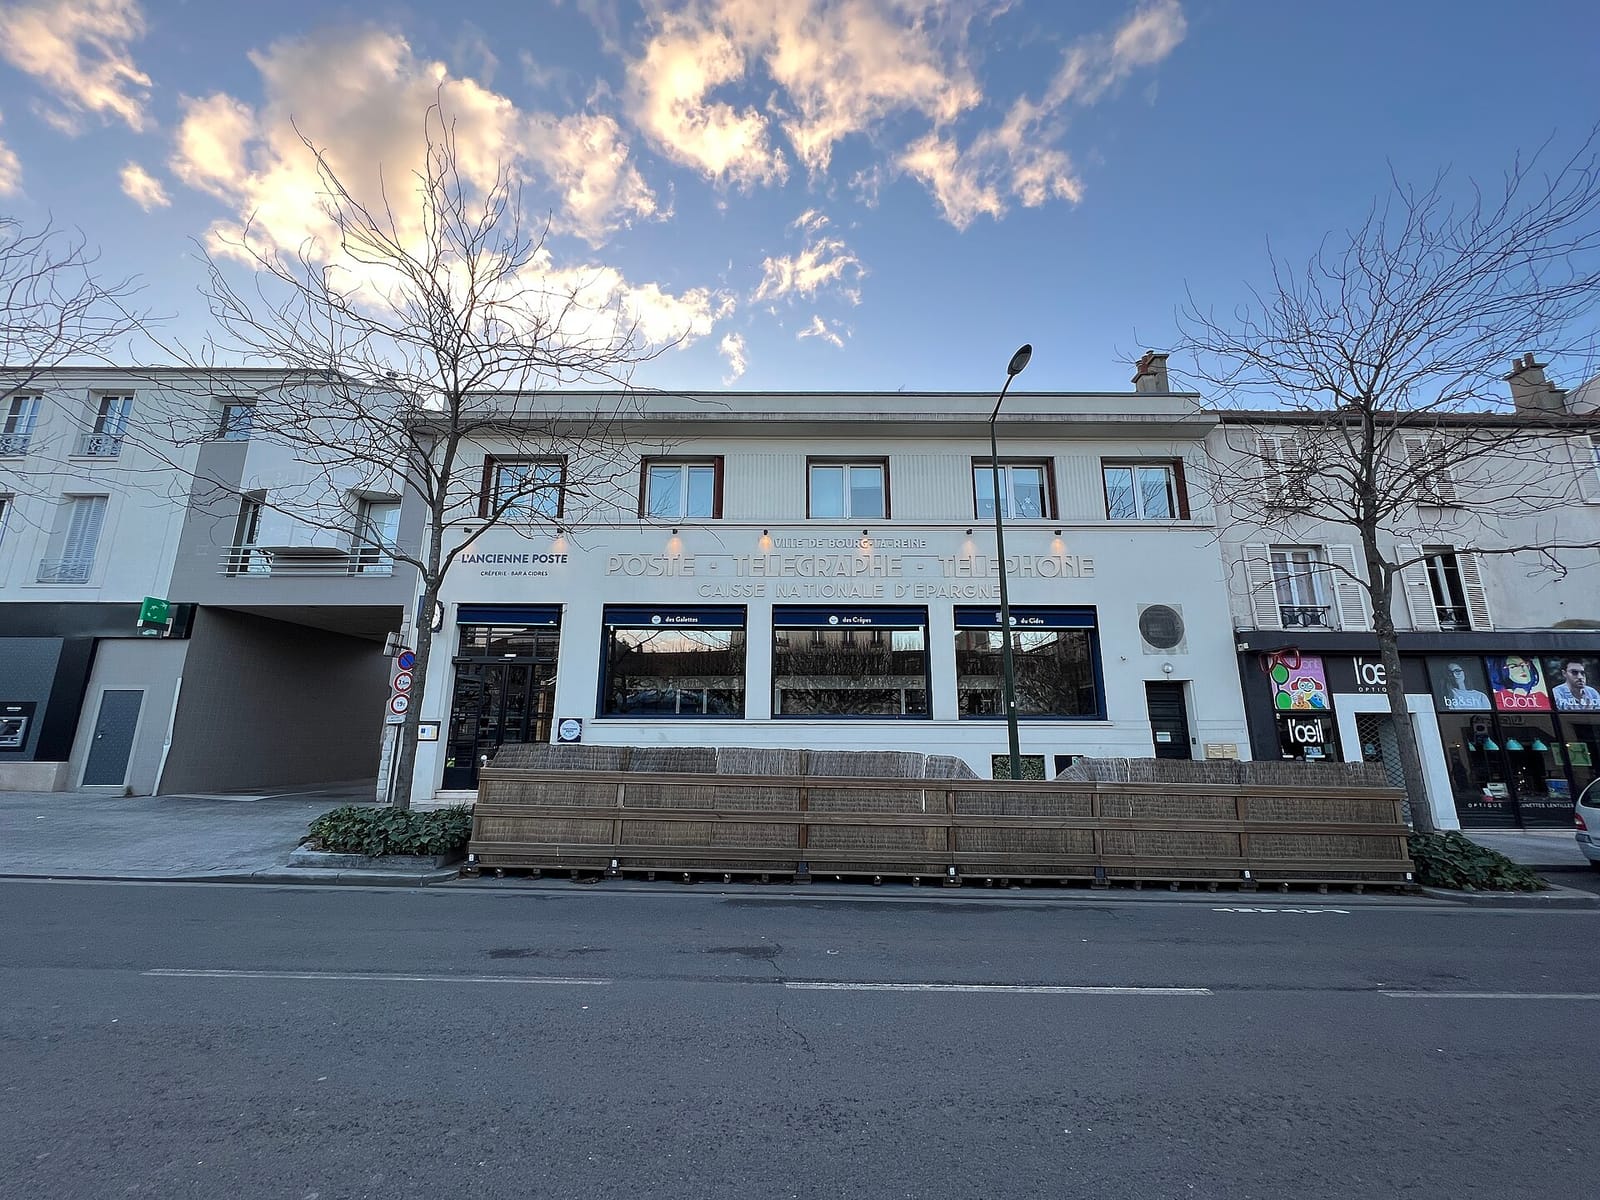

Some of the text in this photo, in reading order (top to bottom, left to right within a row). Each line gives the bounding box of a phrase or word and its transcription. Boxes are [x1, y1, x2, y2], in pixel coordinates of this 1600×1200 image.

[774, 538, 802, 548] VILLE
[808, 539, 823, 548] DE
[461, 553, 568, 564] L'ANCIENNE POSTE
[605, 554, 695, 577] POSTE
[698, 583, 765, 598] CAISSE
[775, 583, 884, 599] NATIONALE
[675, 615, 698, 623] Galettes
